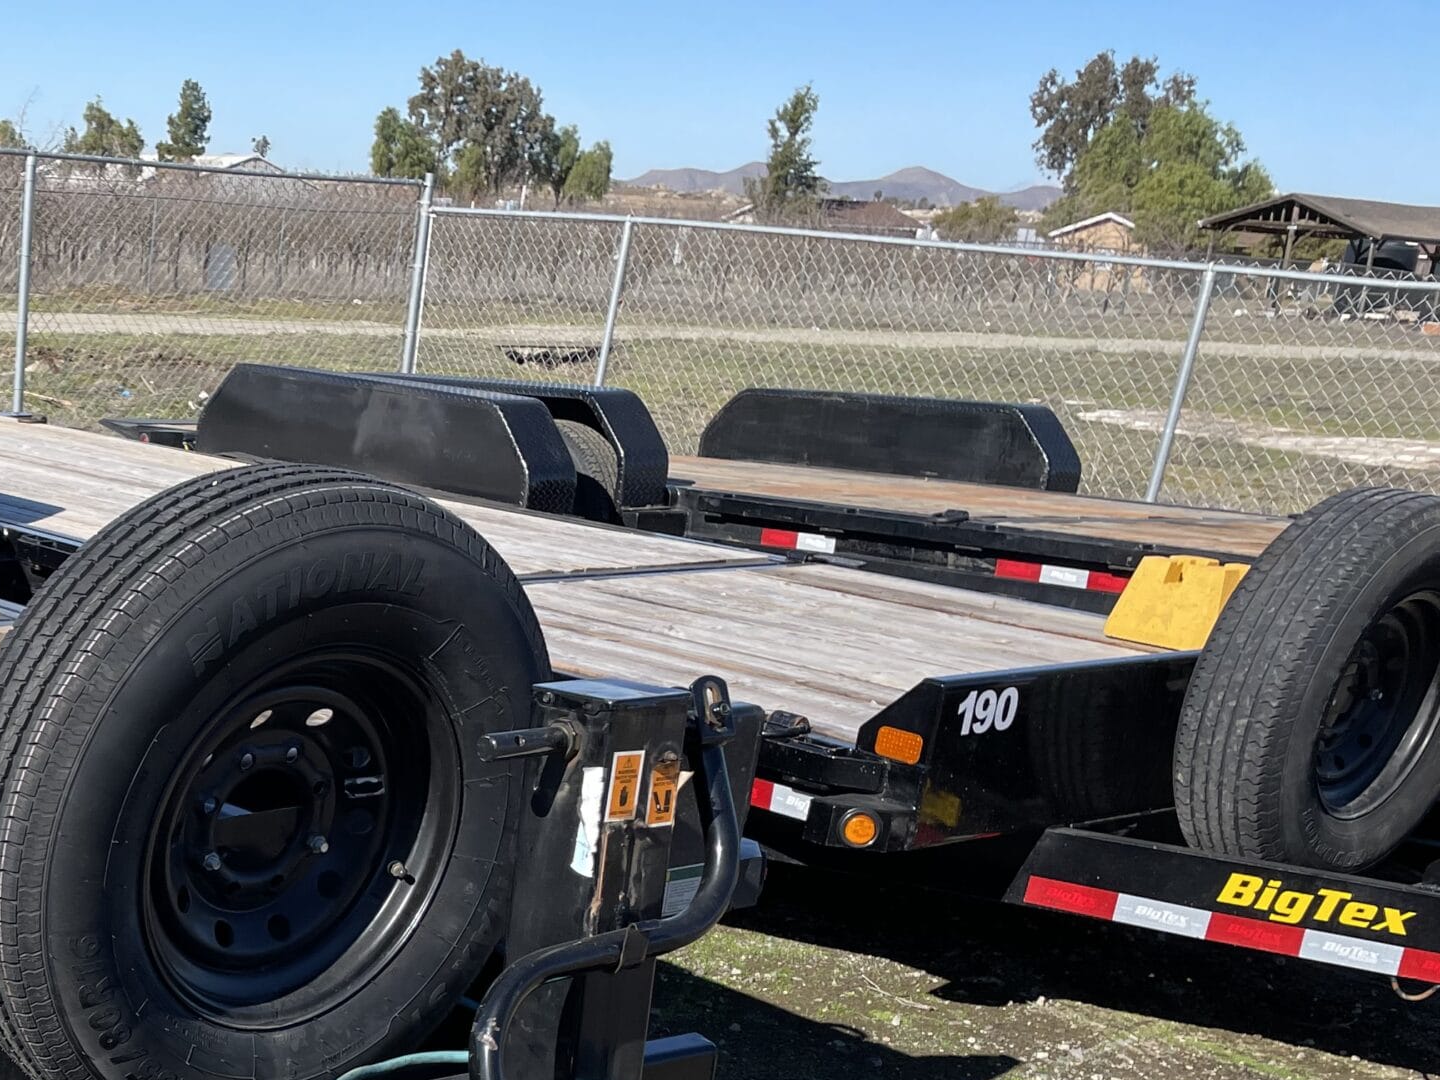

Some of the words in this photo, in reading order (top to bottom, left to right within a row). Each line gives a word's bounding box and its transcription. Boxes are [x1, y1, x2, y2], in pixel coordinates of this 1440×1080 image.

[185, 552, 428, 678] NATIONAL
[957, 686, 1019, 736] 190
[1134, 904, 1190, 927] BigTex
[1216, 872, 1417, 936] BigTex
[1321, 940, 1380, 963] BigTex
